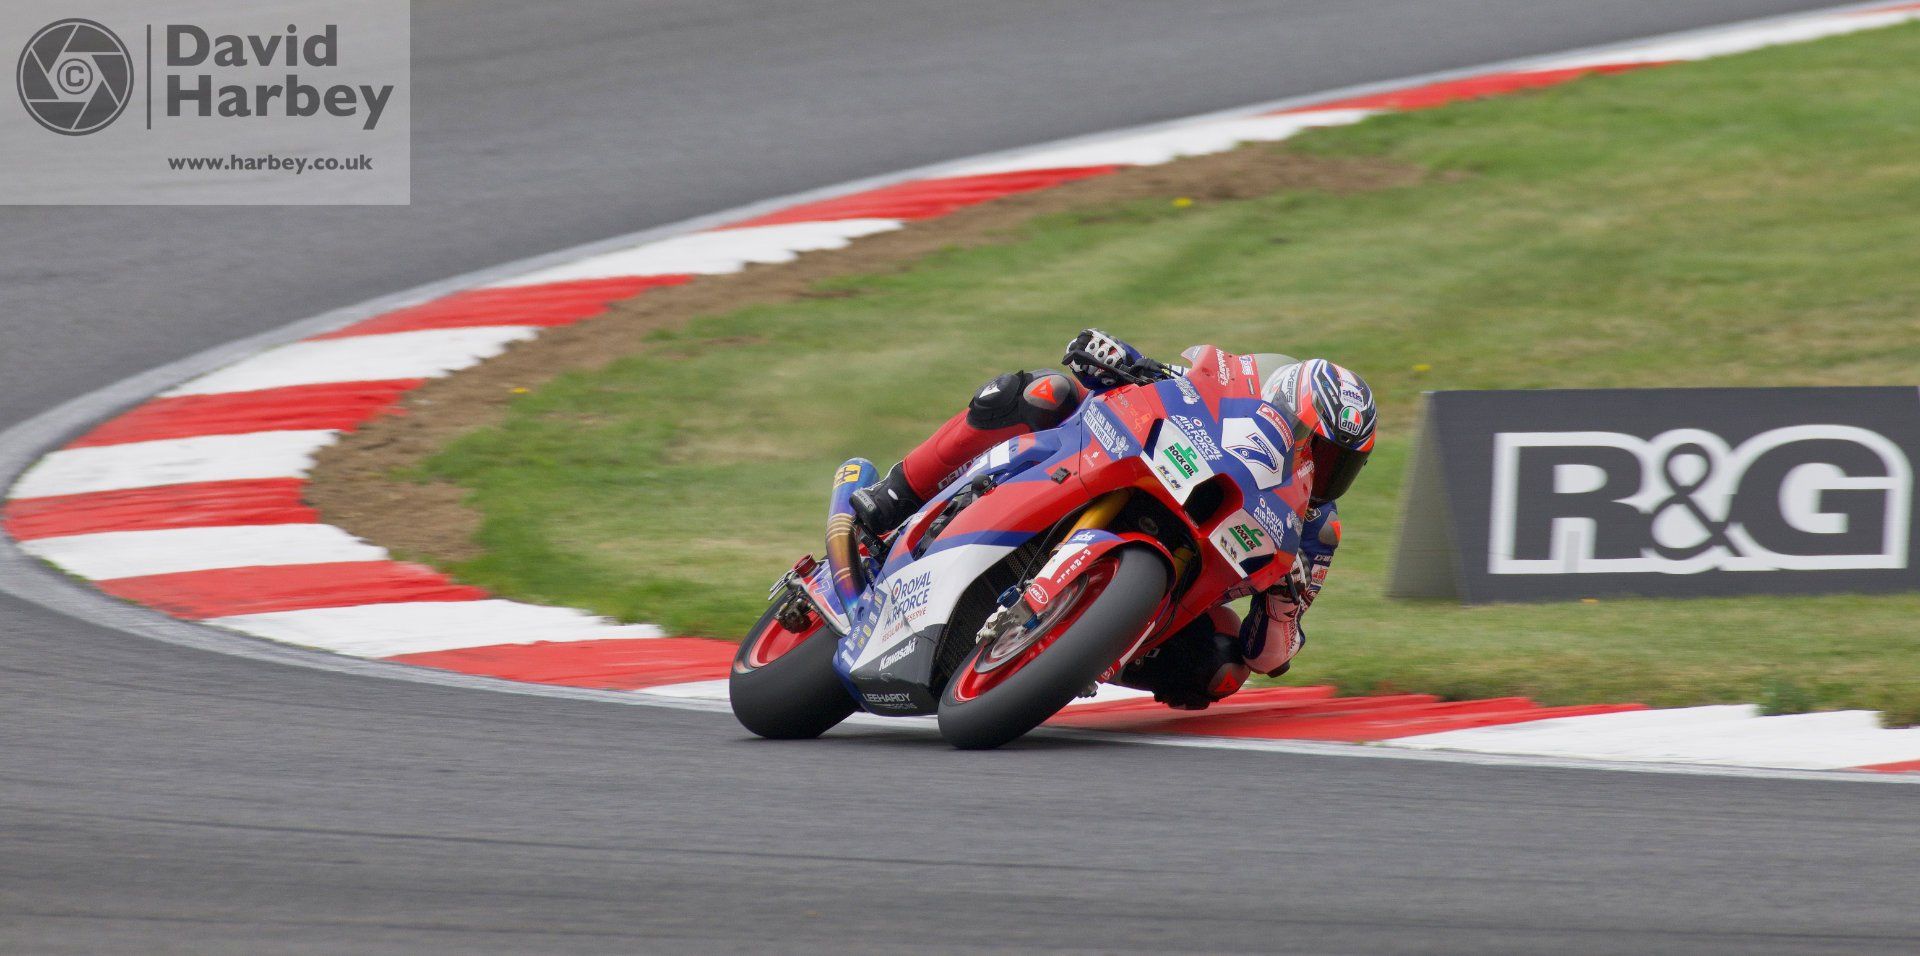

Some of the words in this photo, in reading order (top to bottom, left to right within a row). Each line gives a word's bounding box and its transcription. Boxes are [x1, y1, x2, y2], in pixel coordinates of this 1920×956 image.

[1175, 415, 1194, 430] AIR
[1190, 430, 1217, 460] FORCE
[1342, 419, 1359, 433] agv
[1198, 429, 1223, 460] ROYAL
[1225, 432, 1279, 474] 7
[1168, 445, 1186, 467] ROCK
[1184, 463, 1195, 477] OIL
[1489, 424, 1913, 575] R&G
[1254, 506, 1266, 522] AIR
[1266, 516, 1284, 544] FORCE
[1267, 506, 1284, 534] ROYAL
[1234, 525, 1249, 541] ROCK
[1247, 540, 1257, 550] OIL
[900, 571, 931, 599] ROYAL
[897, 588, 930, 618] FORCE
[879, 637, 916, 671] Kawasaki
